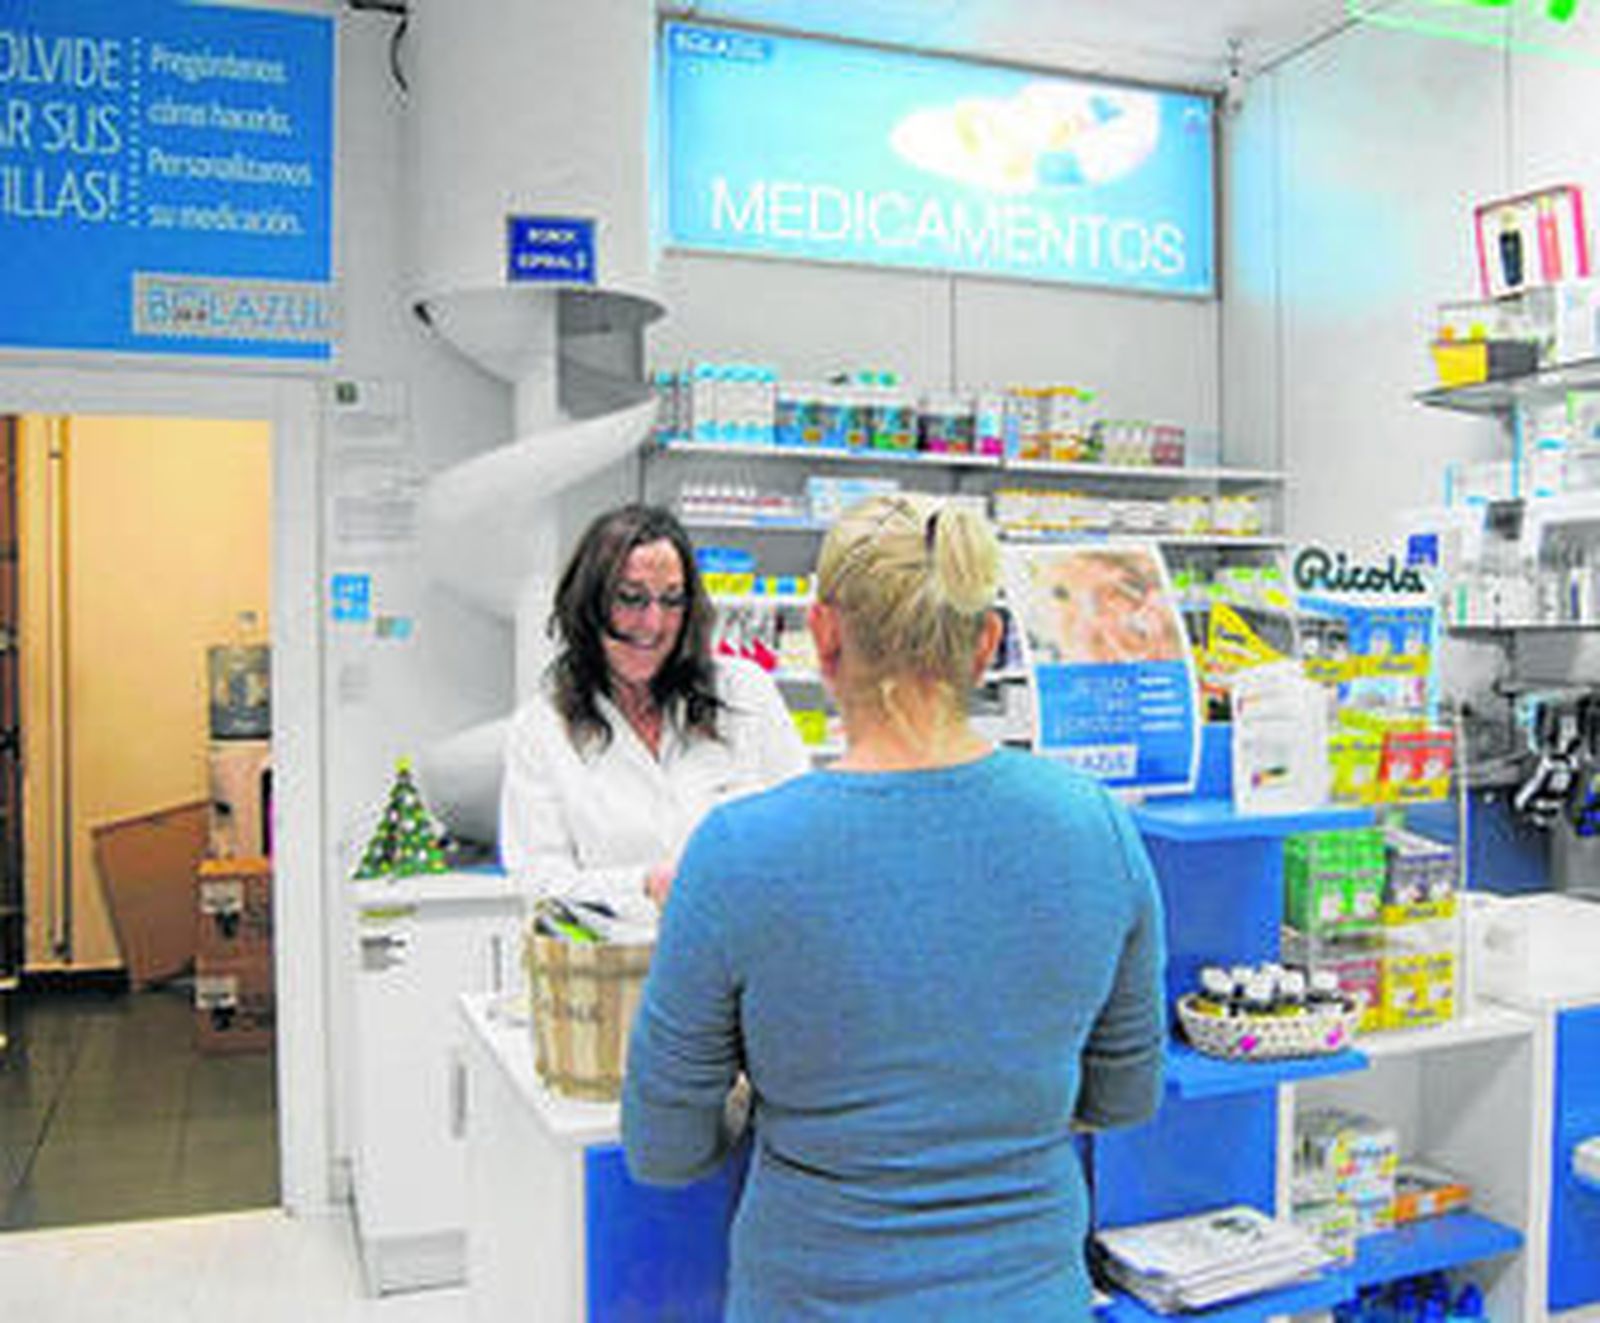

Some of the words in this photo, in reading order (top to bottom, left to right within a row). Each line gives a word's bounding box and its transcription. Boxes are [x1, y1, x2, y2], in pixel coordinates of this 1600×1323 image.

[42, 101, 121, 153] SUS
[709, 176, 1187, 276] MEDICAMENTOS
[1293, 547, 1426, 593] Ricola
